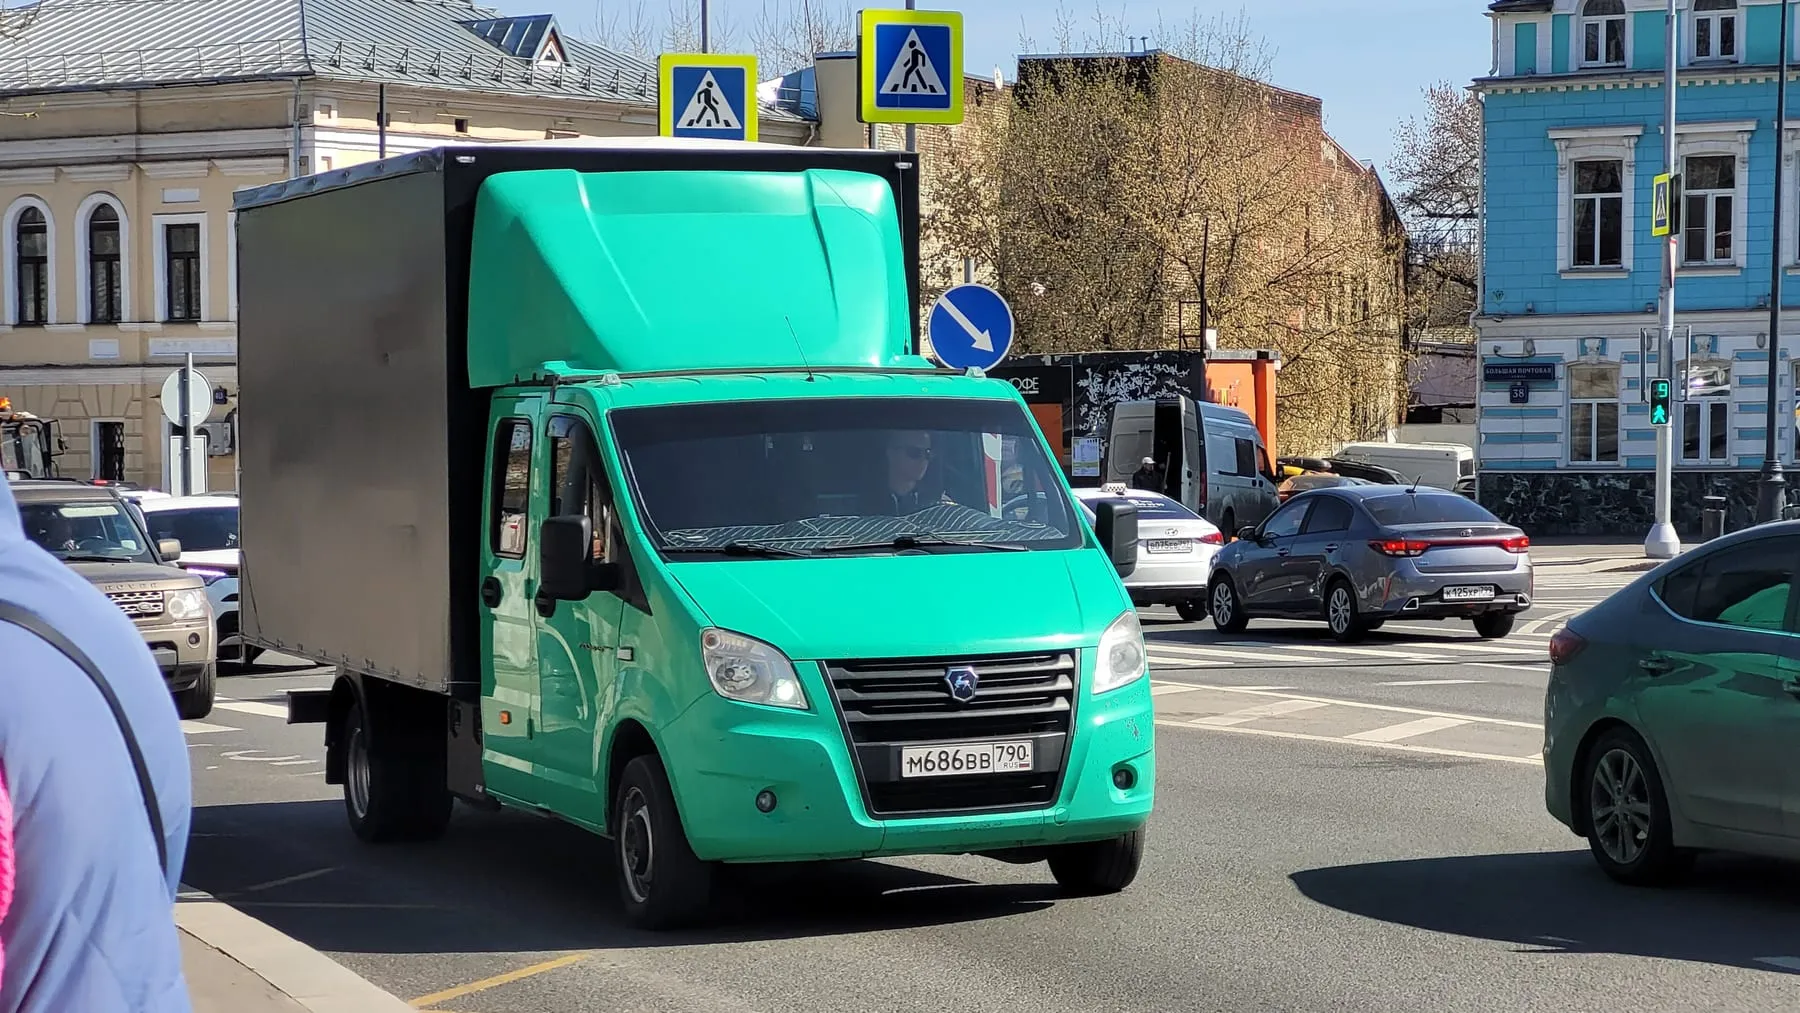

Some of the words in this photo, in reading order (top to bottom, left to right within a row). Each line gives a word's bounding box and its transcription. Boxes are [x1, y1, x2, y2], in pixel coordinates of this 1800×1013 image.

[1512, 388, 1525, 398] 38
[1658, 382, 1668, 398] 9
[908, 749, 991, 774] М686ВВ
[995, 745, 1027, 762] 790
